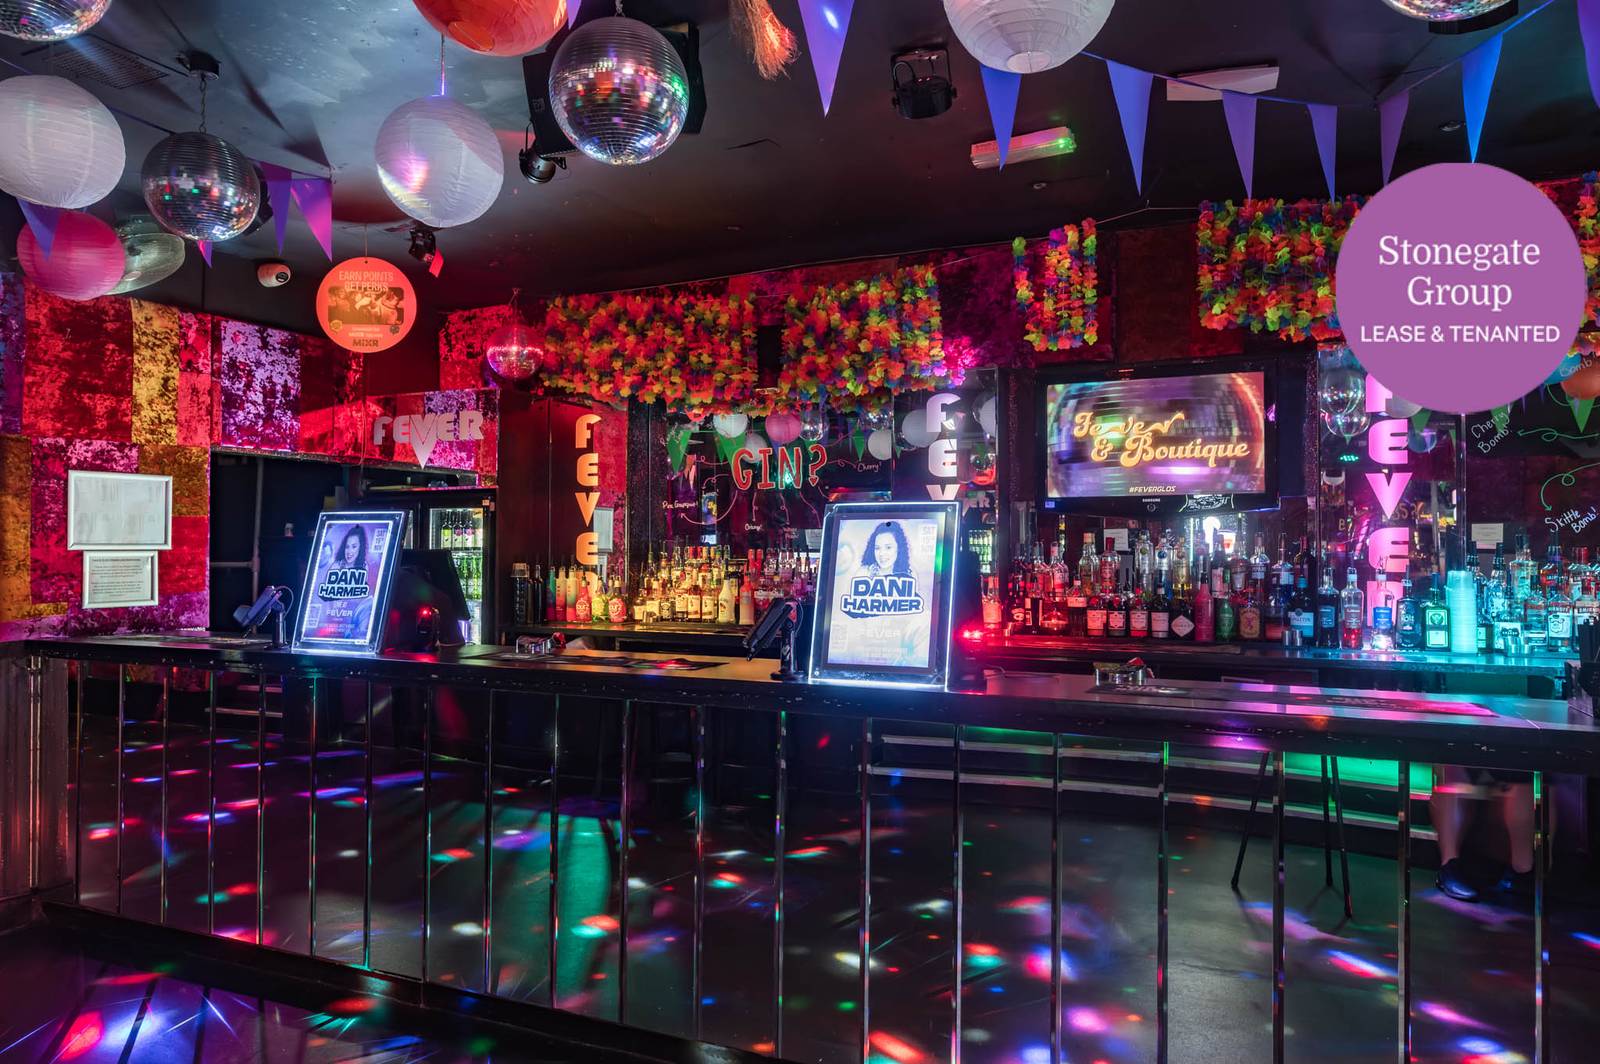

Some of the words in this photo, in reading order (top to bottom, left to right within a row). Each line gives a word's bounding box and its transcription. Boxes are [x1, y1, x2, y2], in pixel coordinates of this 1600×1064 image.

[338, 270, 362, 281] EARN
[363, 270, 394, 281] POINTS
[344, 281, 360, 291] GET
[361, 281, 389, 292] PERKS
[1073, 412, 1185, 440] Fever
[373, 410, 484, 469] FEVER
[1091, 439, 1112, 462] &
[1119, 433, 1250, 467] Boutique
[1128, 485, 1177, 494] #FEVERGLOS
[1545, 509, 1581, 533] Skittle
[327, 571, 366, 586] DANI
[319, 584, 367, 597] HARMER
[853, 578, 914, 597] DANI
[843, 597, 922, 612] HARMER
